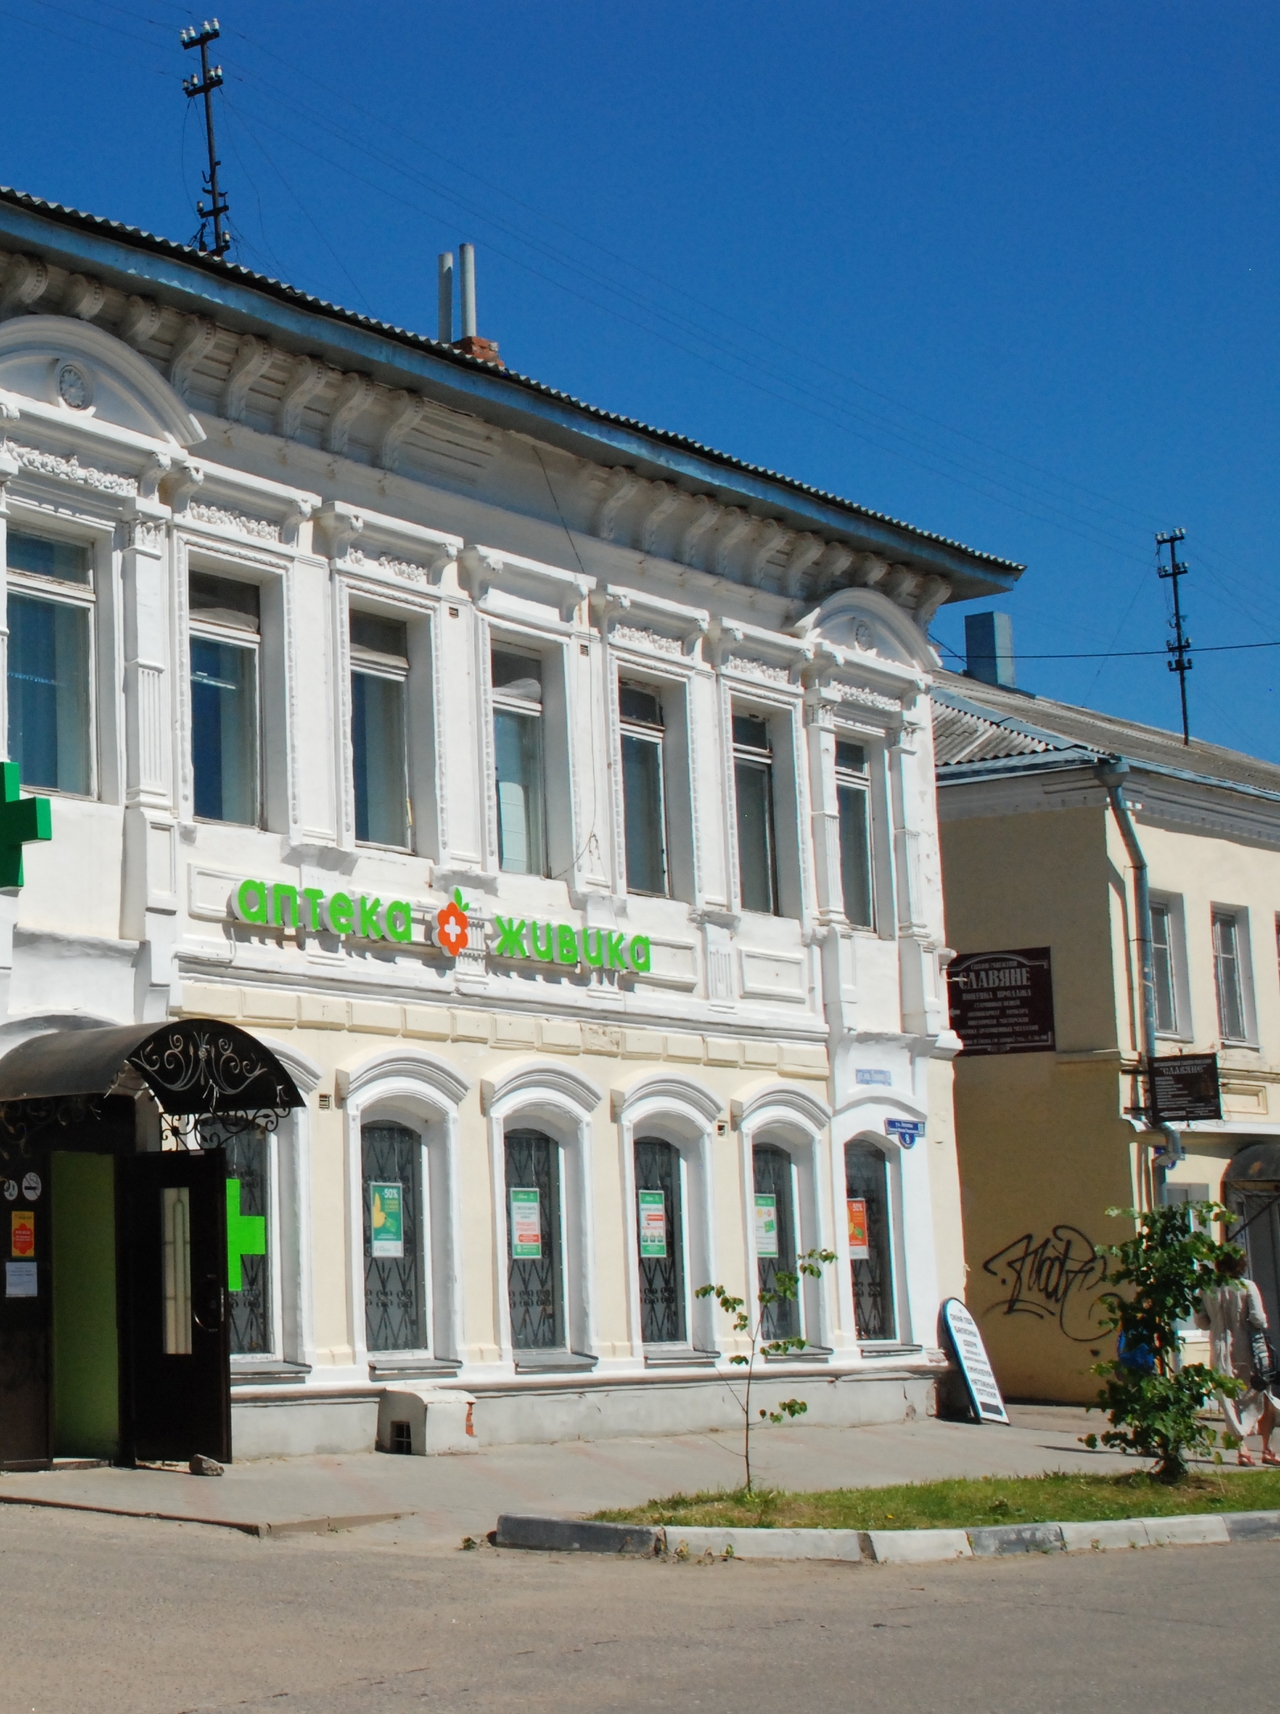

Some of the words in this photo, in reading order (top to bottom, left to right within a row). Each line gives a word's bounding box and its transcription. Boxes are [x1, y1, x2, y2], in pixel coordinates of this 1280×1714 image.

[235, 879, 412, 943] аптека
[495, 915, 651, 973] живика
[958, 967, 1030, 990] СЛАВЯНЕ
